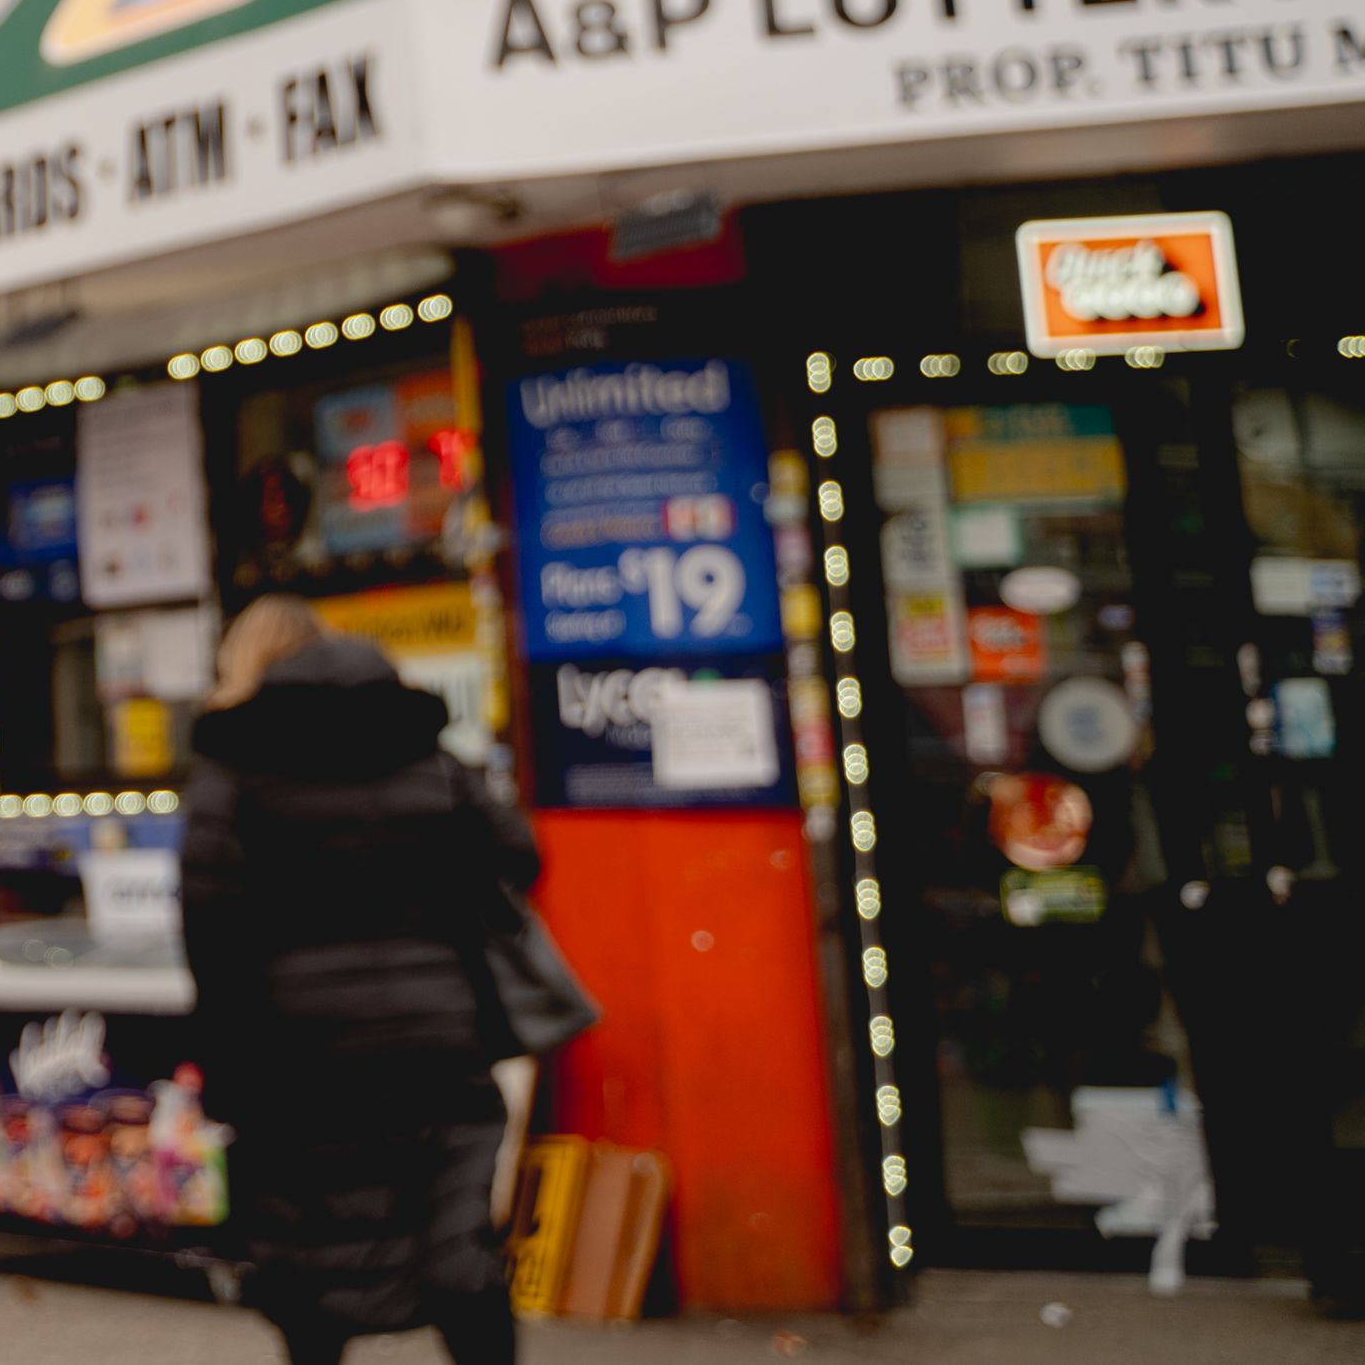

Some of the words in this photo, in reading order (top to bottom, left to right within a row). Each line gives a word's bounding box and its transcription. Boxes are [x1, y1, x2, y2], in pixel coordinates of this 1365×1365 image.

[893, 51, 1103, 111] PROP.
[1119, 22, 1308, 89] TITU
[125, 94, 232, 207] ATM
[281, 52, 387, 166] FAX
[521, 358, 731, 430] Unlimited
